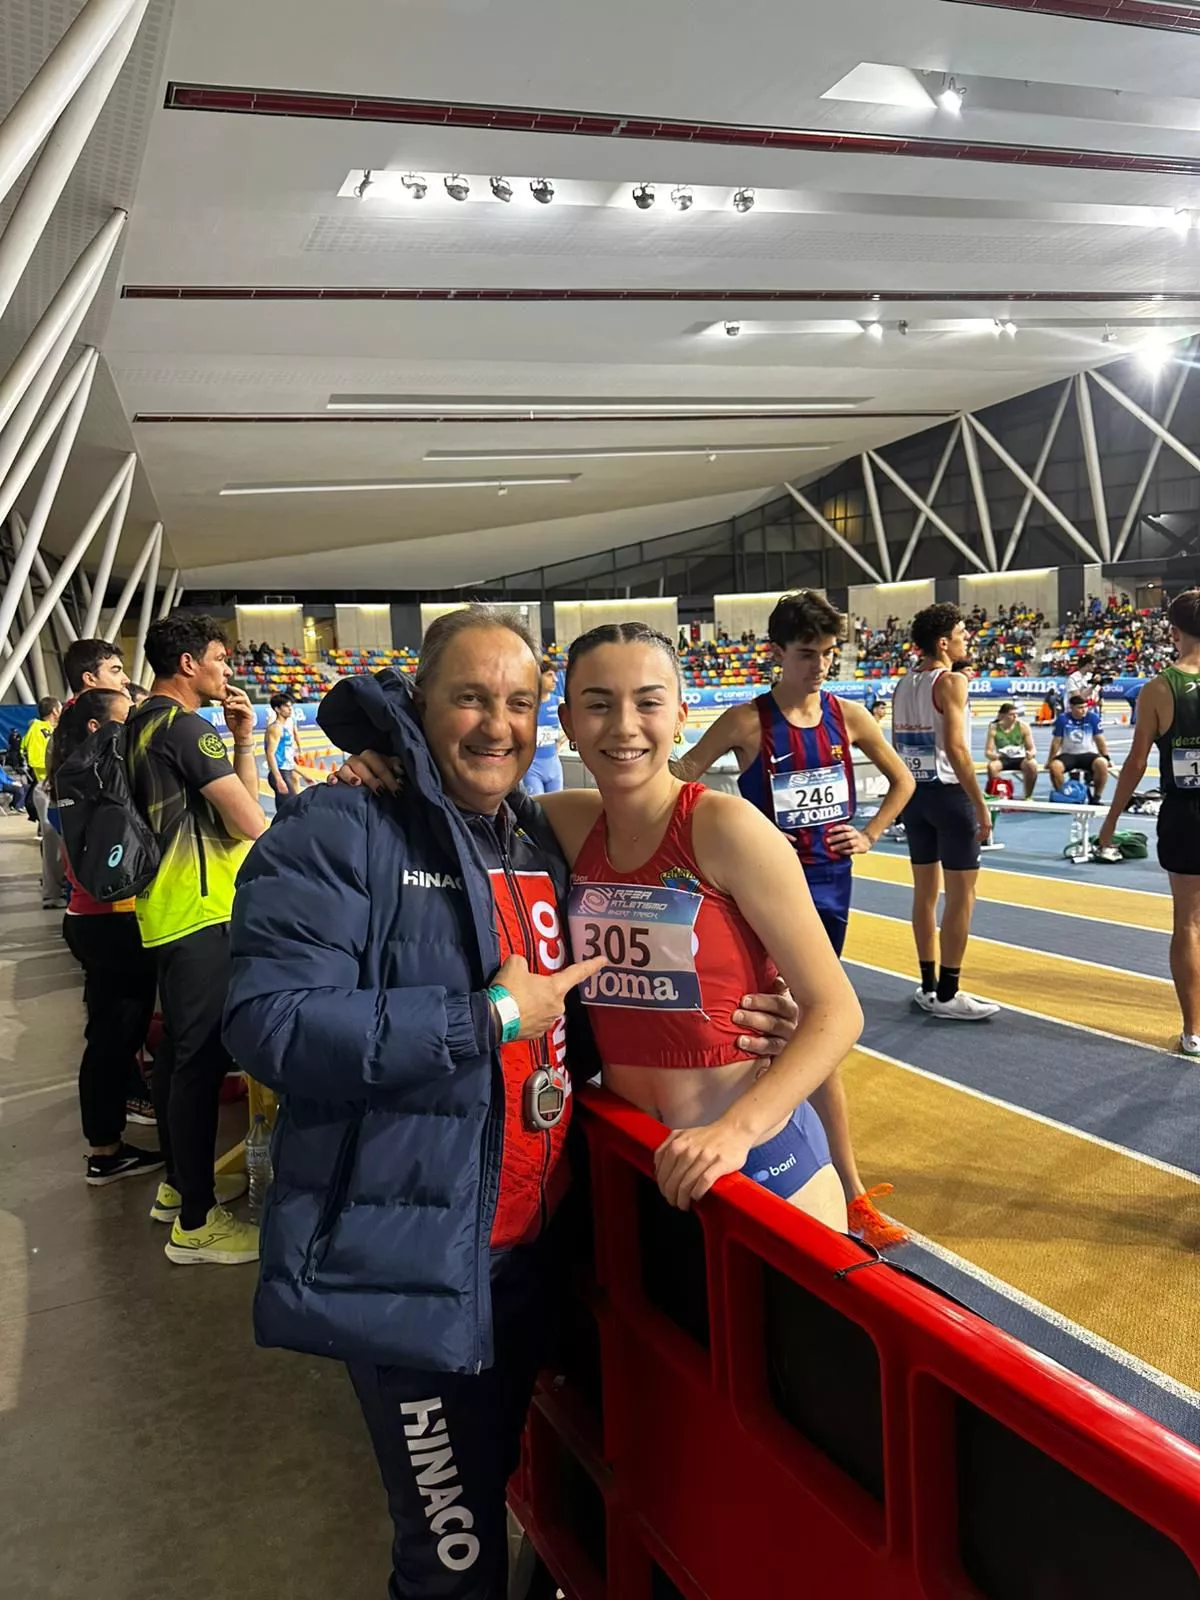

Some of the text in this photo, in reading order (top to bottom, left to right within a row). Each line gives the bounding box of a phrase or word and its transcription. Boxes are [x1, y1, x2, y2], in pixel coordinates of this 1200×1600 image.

[795, 785, 834, 808] 246
[610, 900, 668, 911] ATLETISMO
[582, 923, 651, 968] 305
[400, 1396, 481, 1571] HINACO
